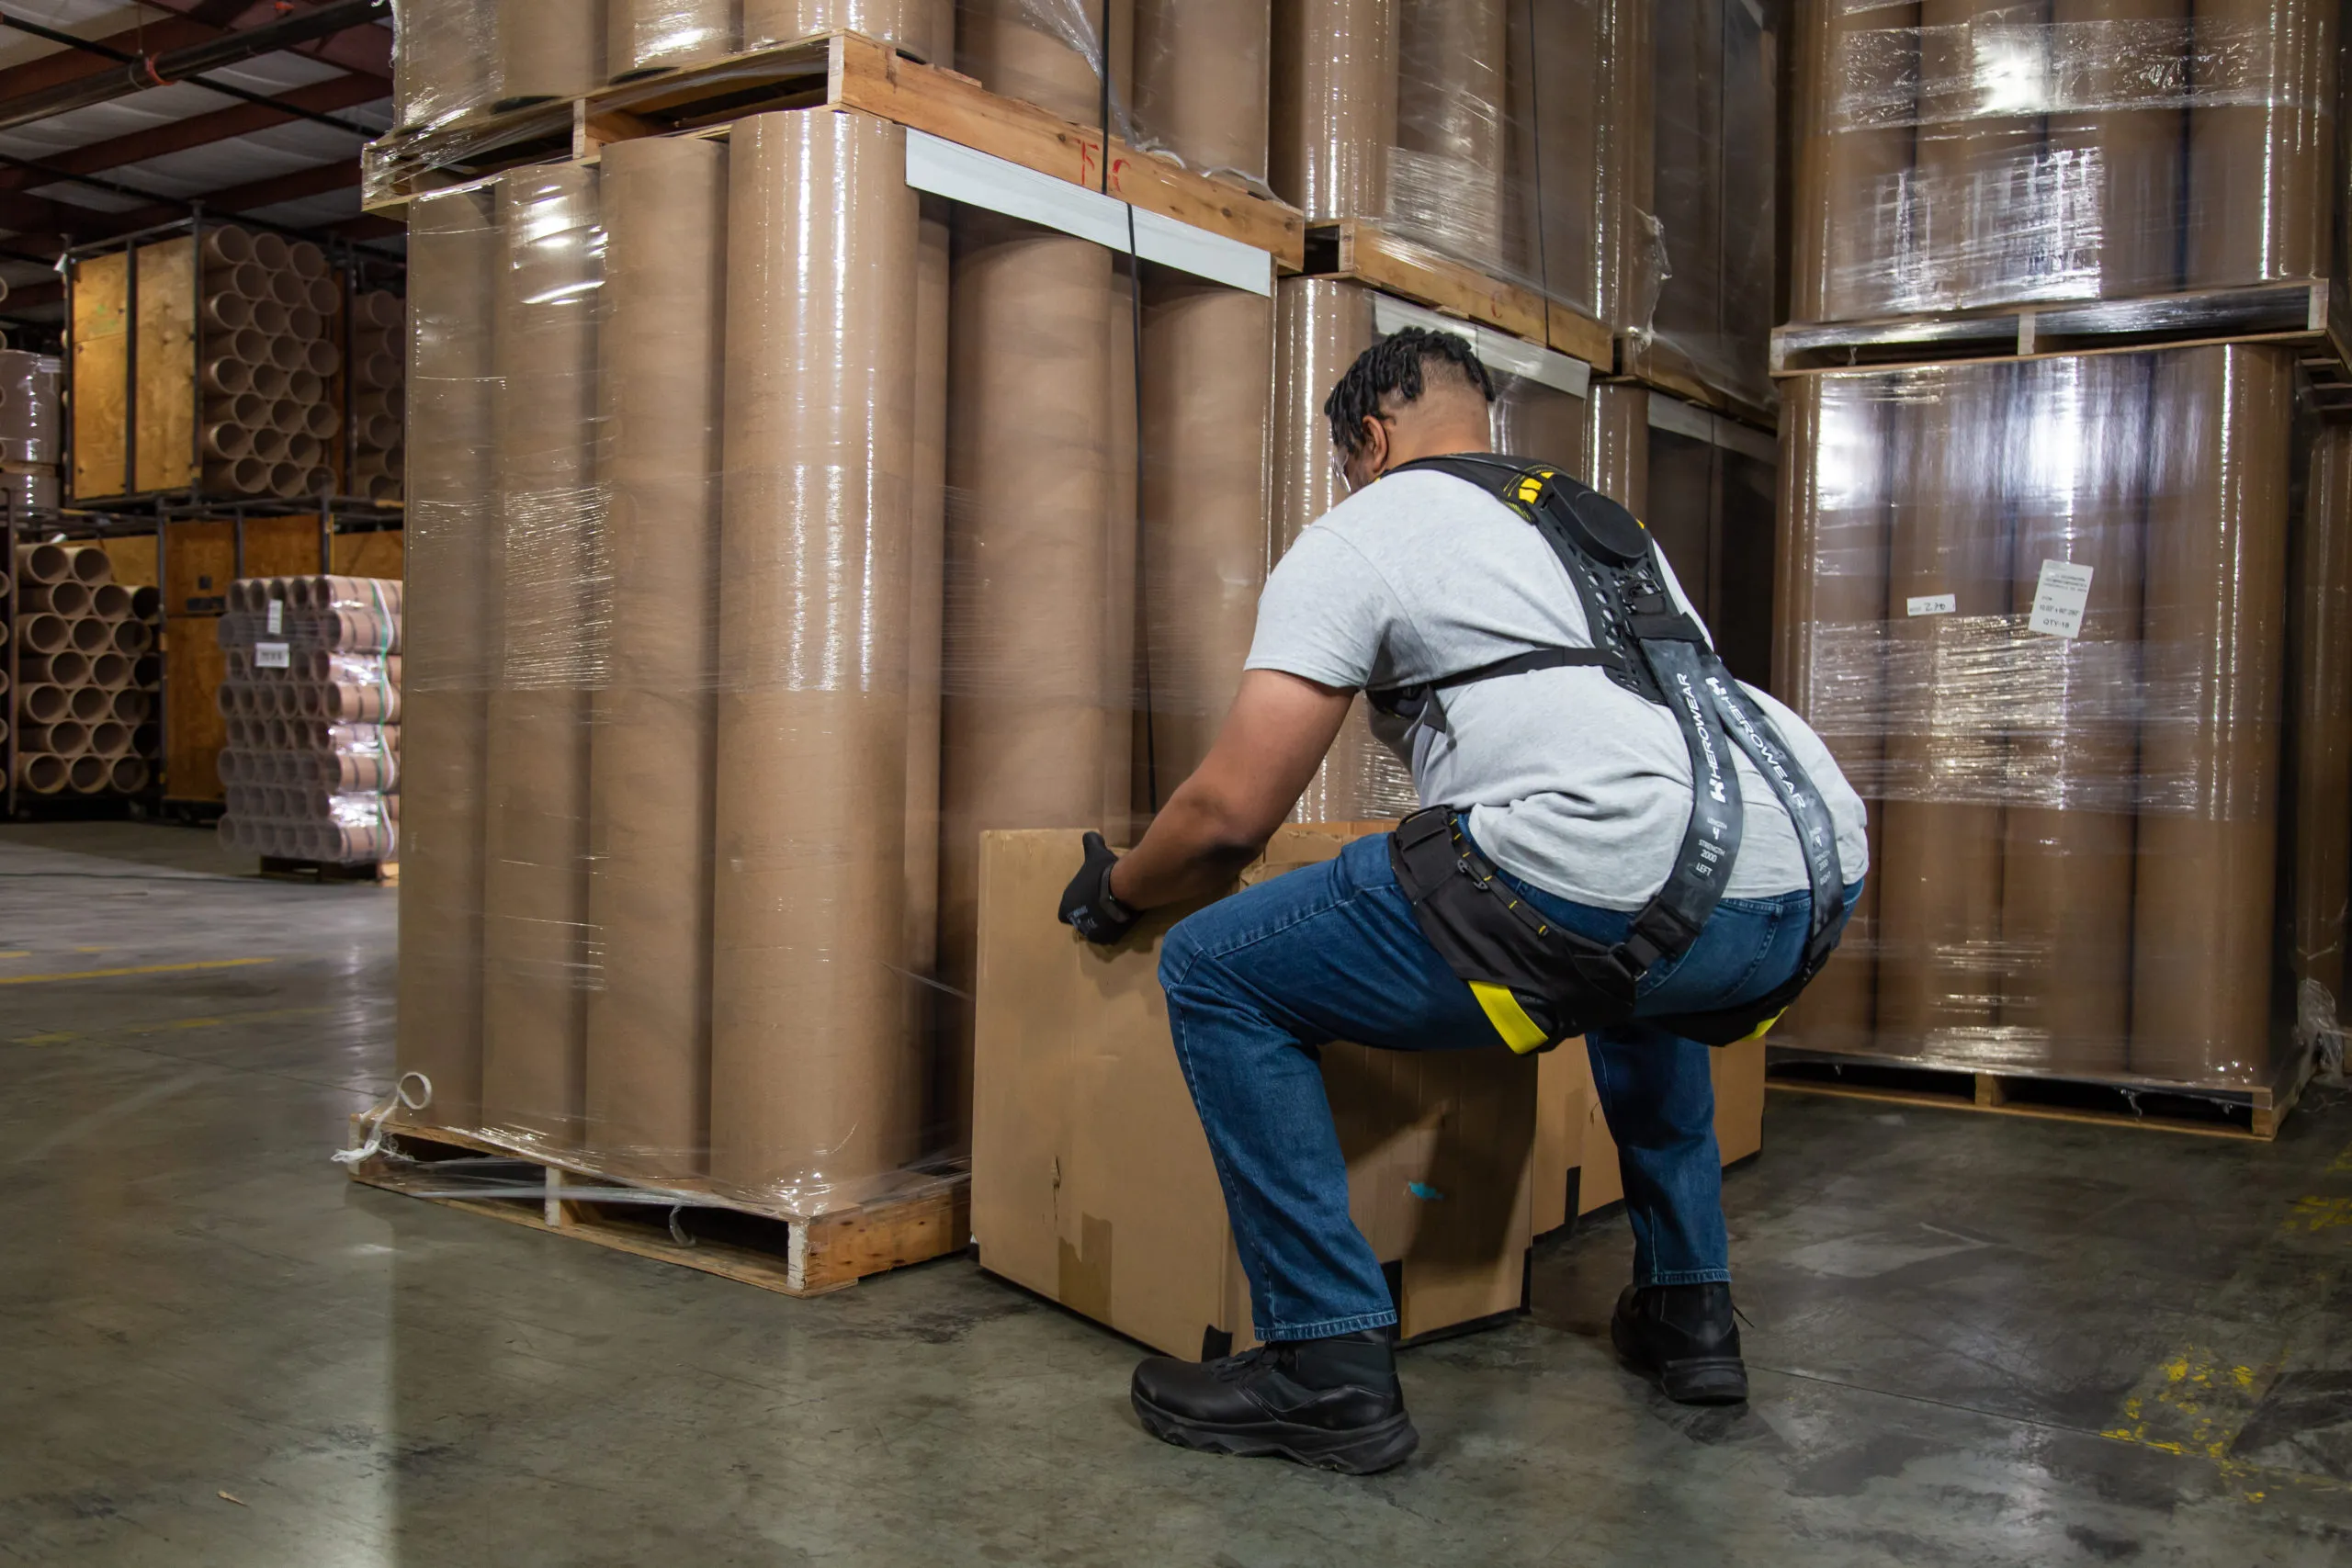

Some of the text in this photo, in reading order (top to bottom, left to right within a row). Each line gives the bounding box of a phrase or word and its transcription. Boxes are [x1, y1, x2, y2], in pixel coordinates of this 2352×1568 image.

[1677, 672, 1722, 780] HEROWEAR
[1721, 695, 1806, 808] HEROWEAR
[1707, 817, 1727, 830] LENGTH
[1713, 827, 1720, 840] 4
[1698, 839, 1726, 856] STRENGTH
[1700, 849, 1718, 863] 2000
[1696, 862, 1713, 876] LEFT
